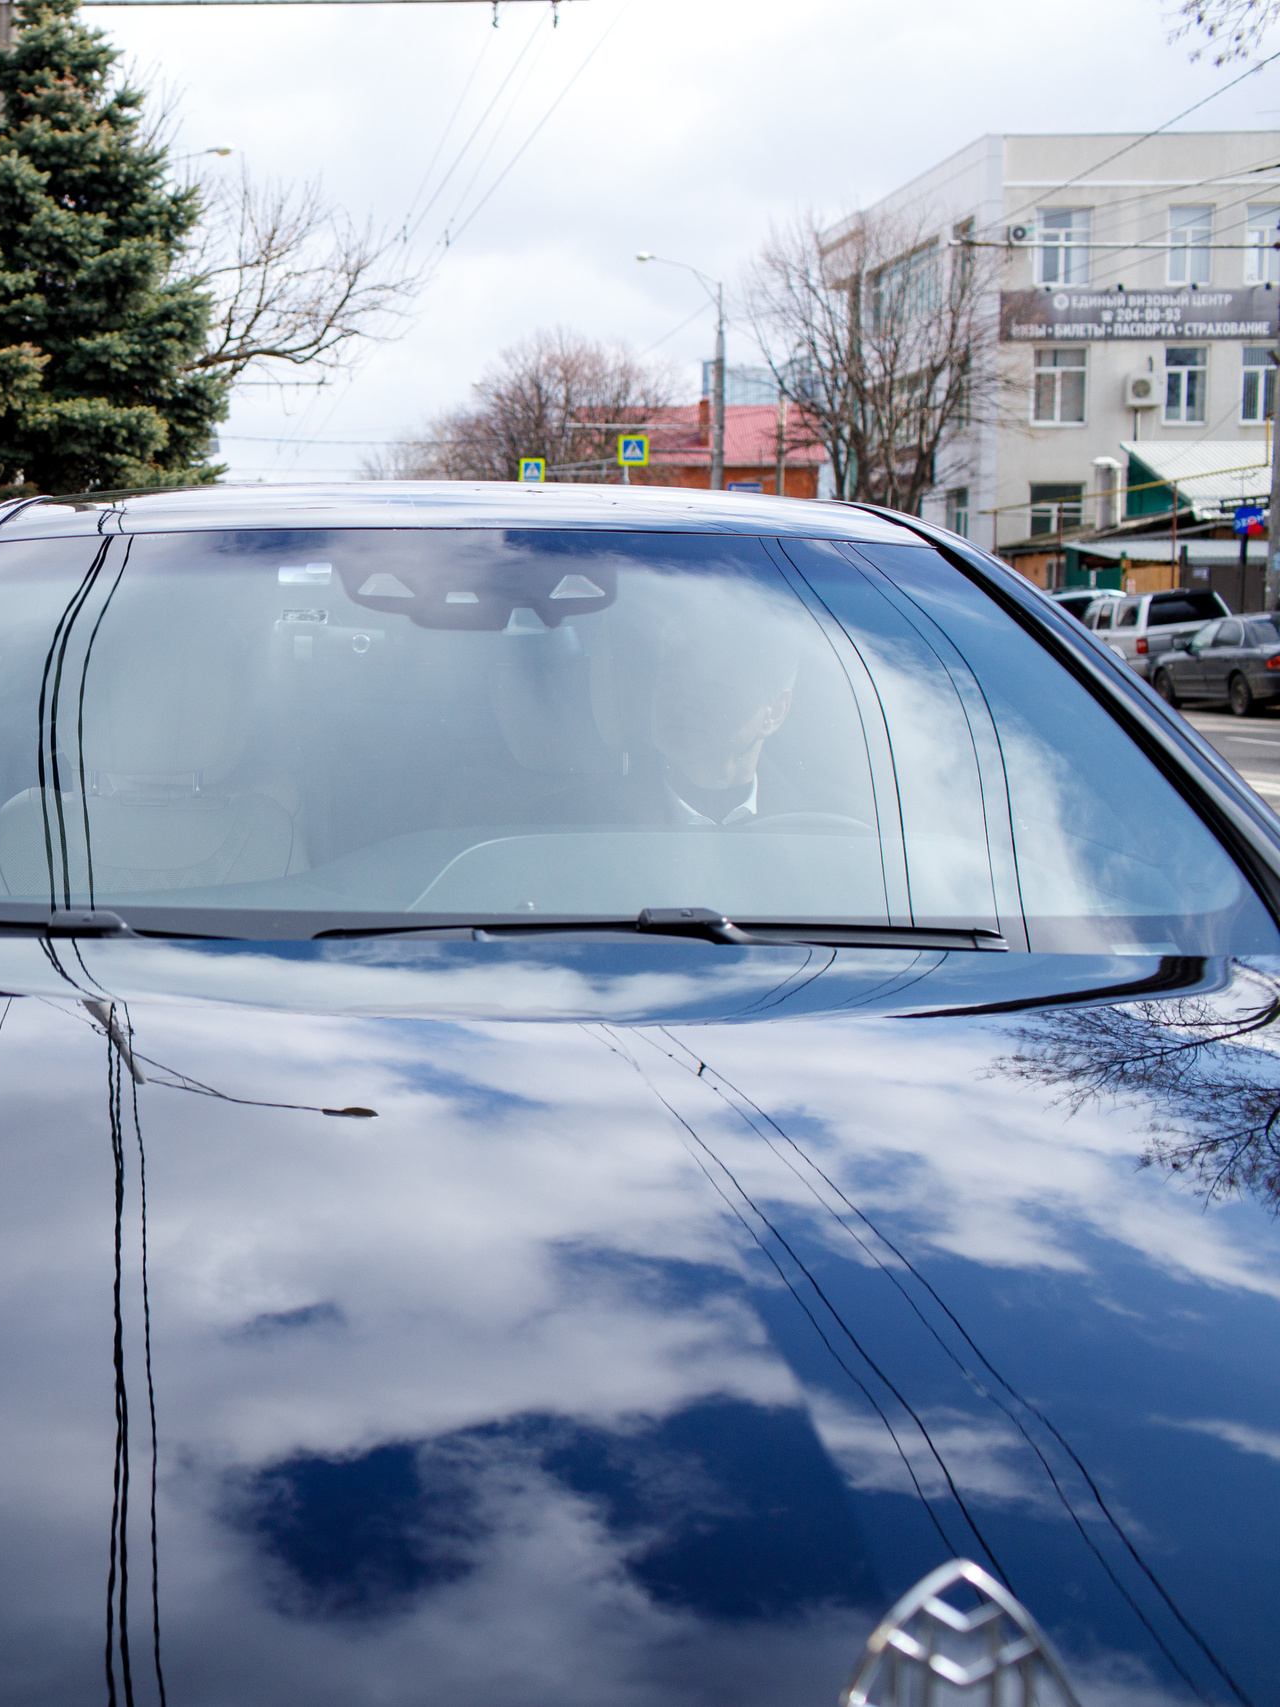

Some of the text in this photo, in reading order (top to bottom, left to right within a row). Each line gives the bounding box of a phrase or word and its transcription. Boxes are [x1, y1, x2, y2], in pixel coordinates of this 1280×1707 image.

[1071, 292, 1233, 308] ЕДИНЫЙ ВИЗОВЫЙ ЦЕНТР
[1116, 308, 1181, 322] 204-00-93
[1053, 322, 1106, 338] БИЛЕТЫ
[1113, 322, 1176, 337] ПАСПОРТА
[1183, 321, 1270, 337] СТРАХОВАНИЕ
